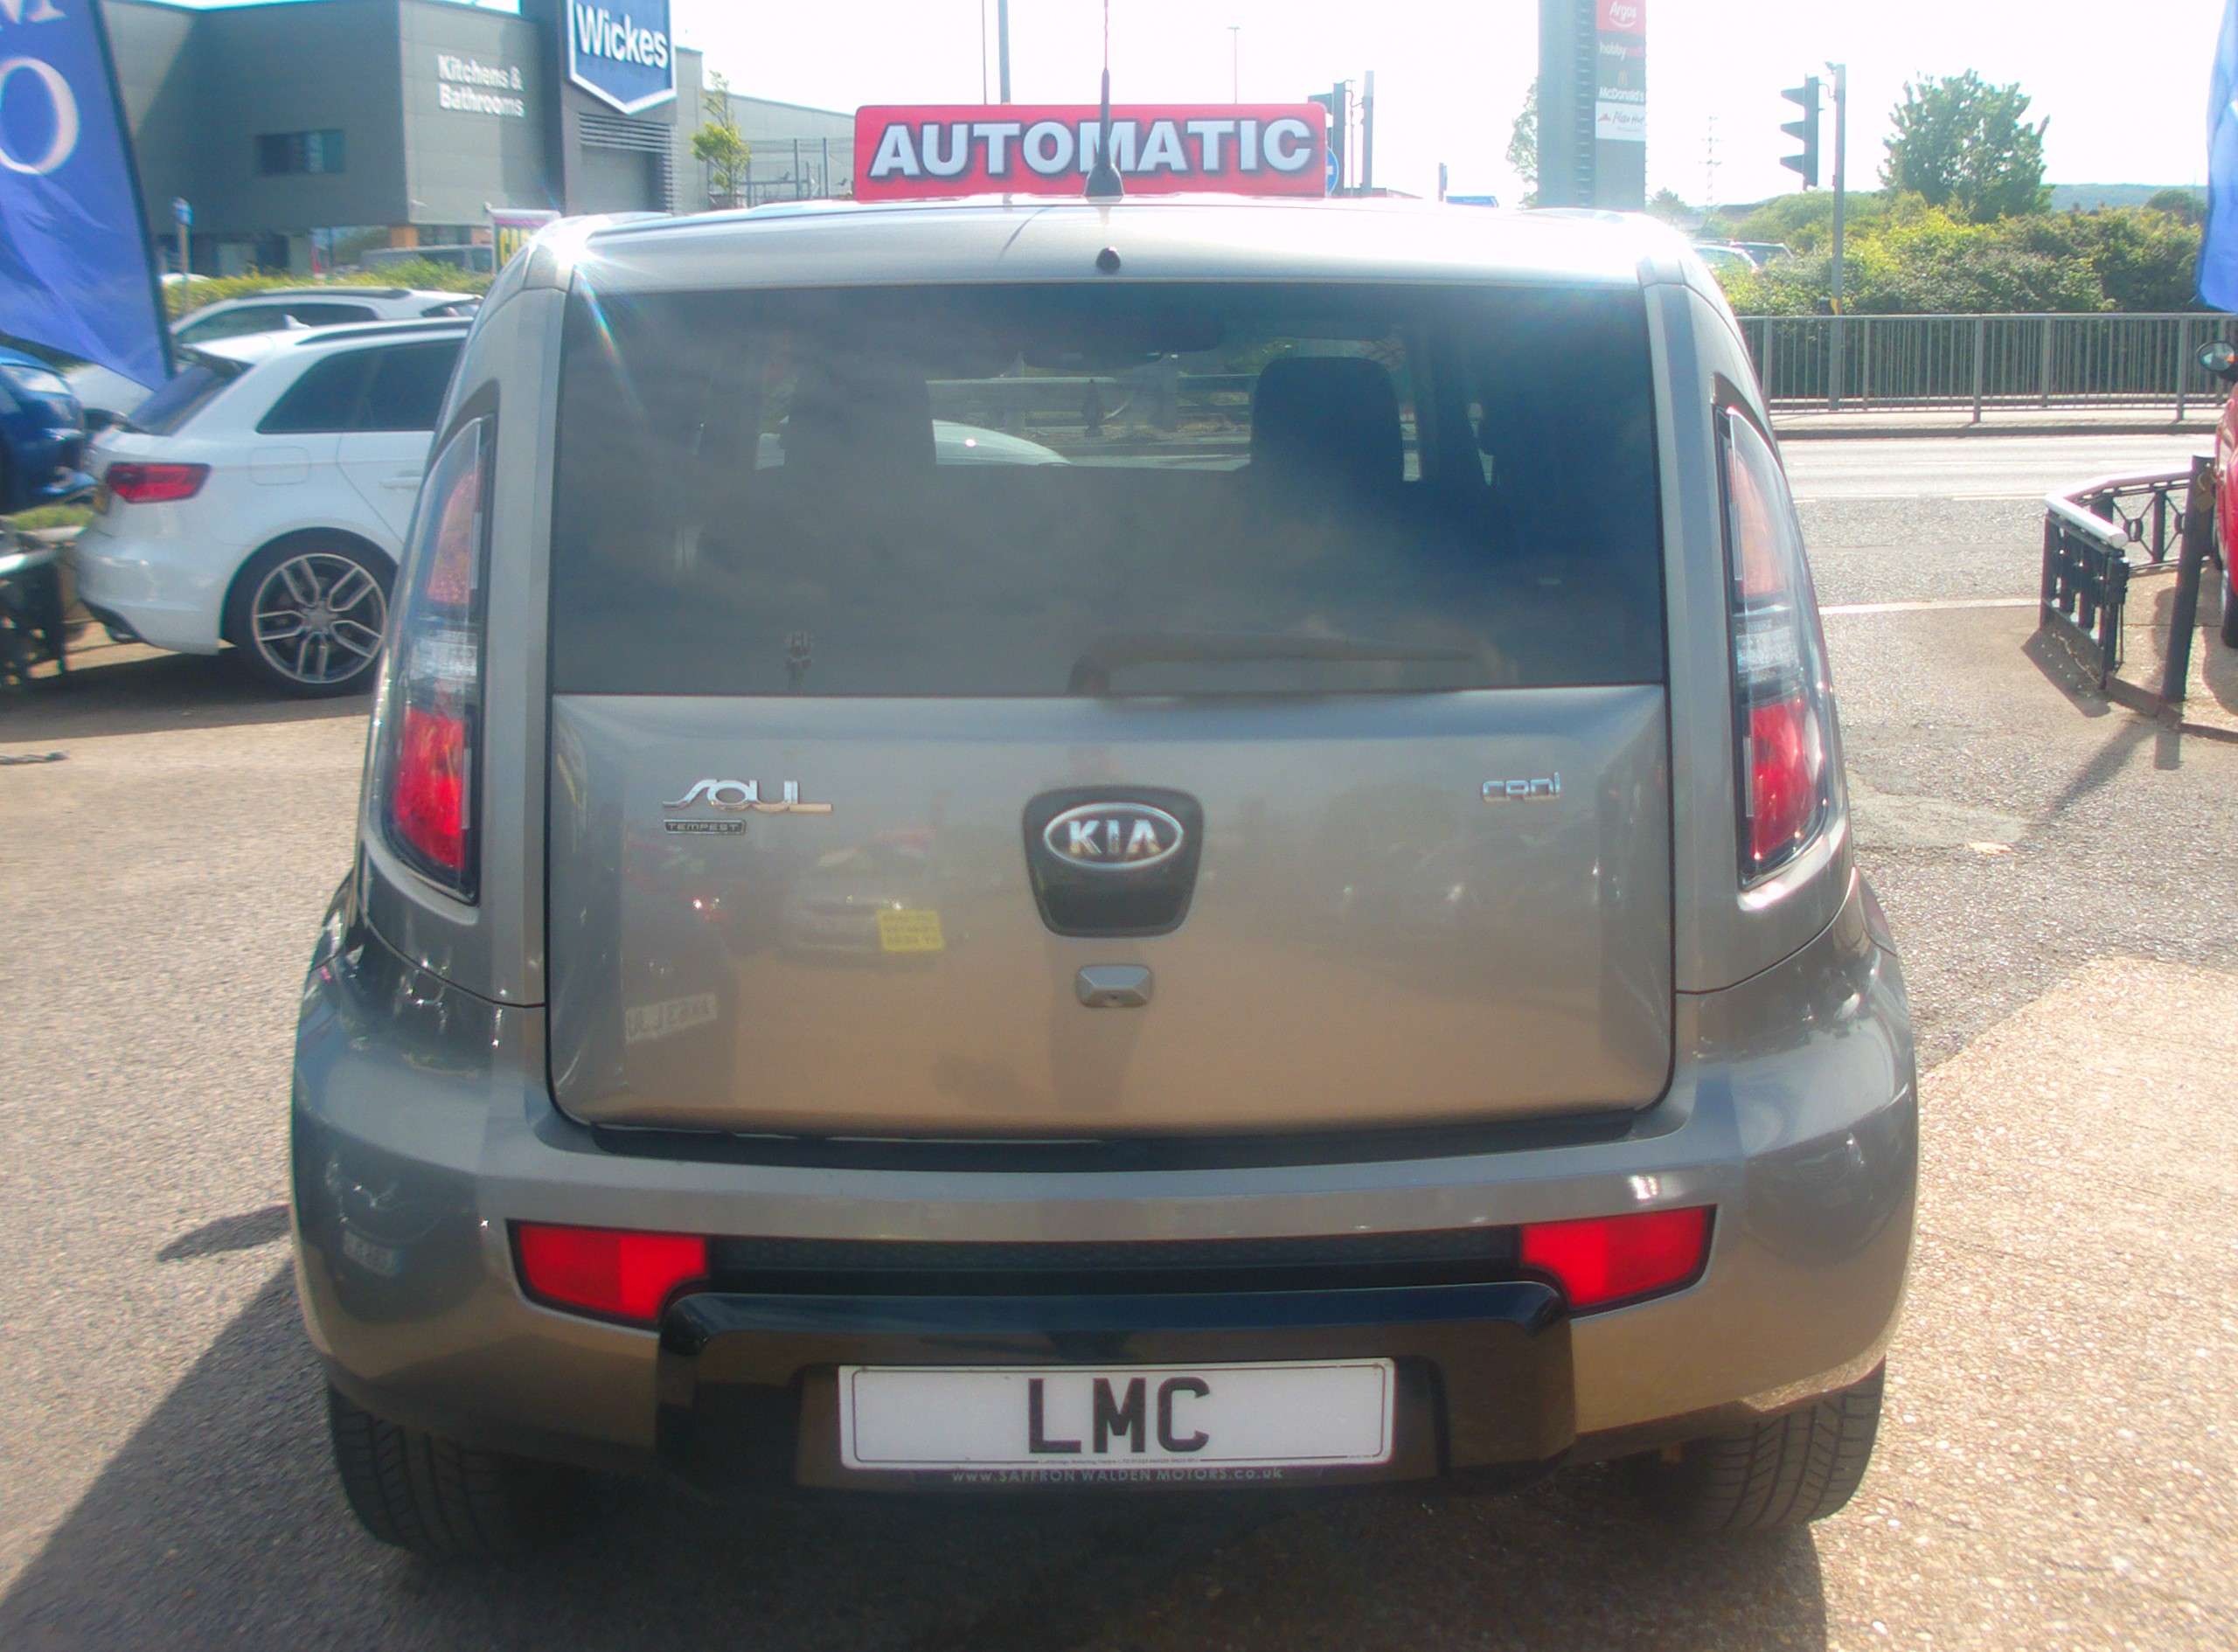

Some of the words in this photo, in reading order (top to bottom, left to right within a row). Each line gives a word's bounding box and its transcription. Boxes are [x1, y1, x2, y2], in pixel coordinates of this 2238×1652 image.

[1609, 0, 1637, 21] Argos
[576, 4, 668, 69] Wickes
[438, 54, 509, 87] Kitchens
[510, 66, 523, 91] &
[439, 83, 525, 118] Bathrooms
[869, 119, 1311, 177] AUTOMATIC
[668, 823, 740, 831] TEMPEST
[1068, 820, 1160, 855] KIA
[1029, 1377, 1210, 1454] LMC
[1081, 1470, 1150, 1482] WALDEN
